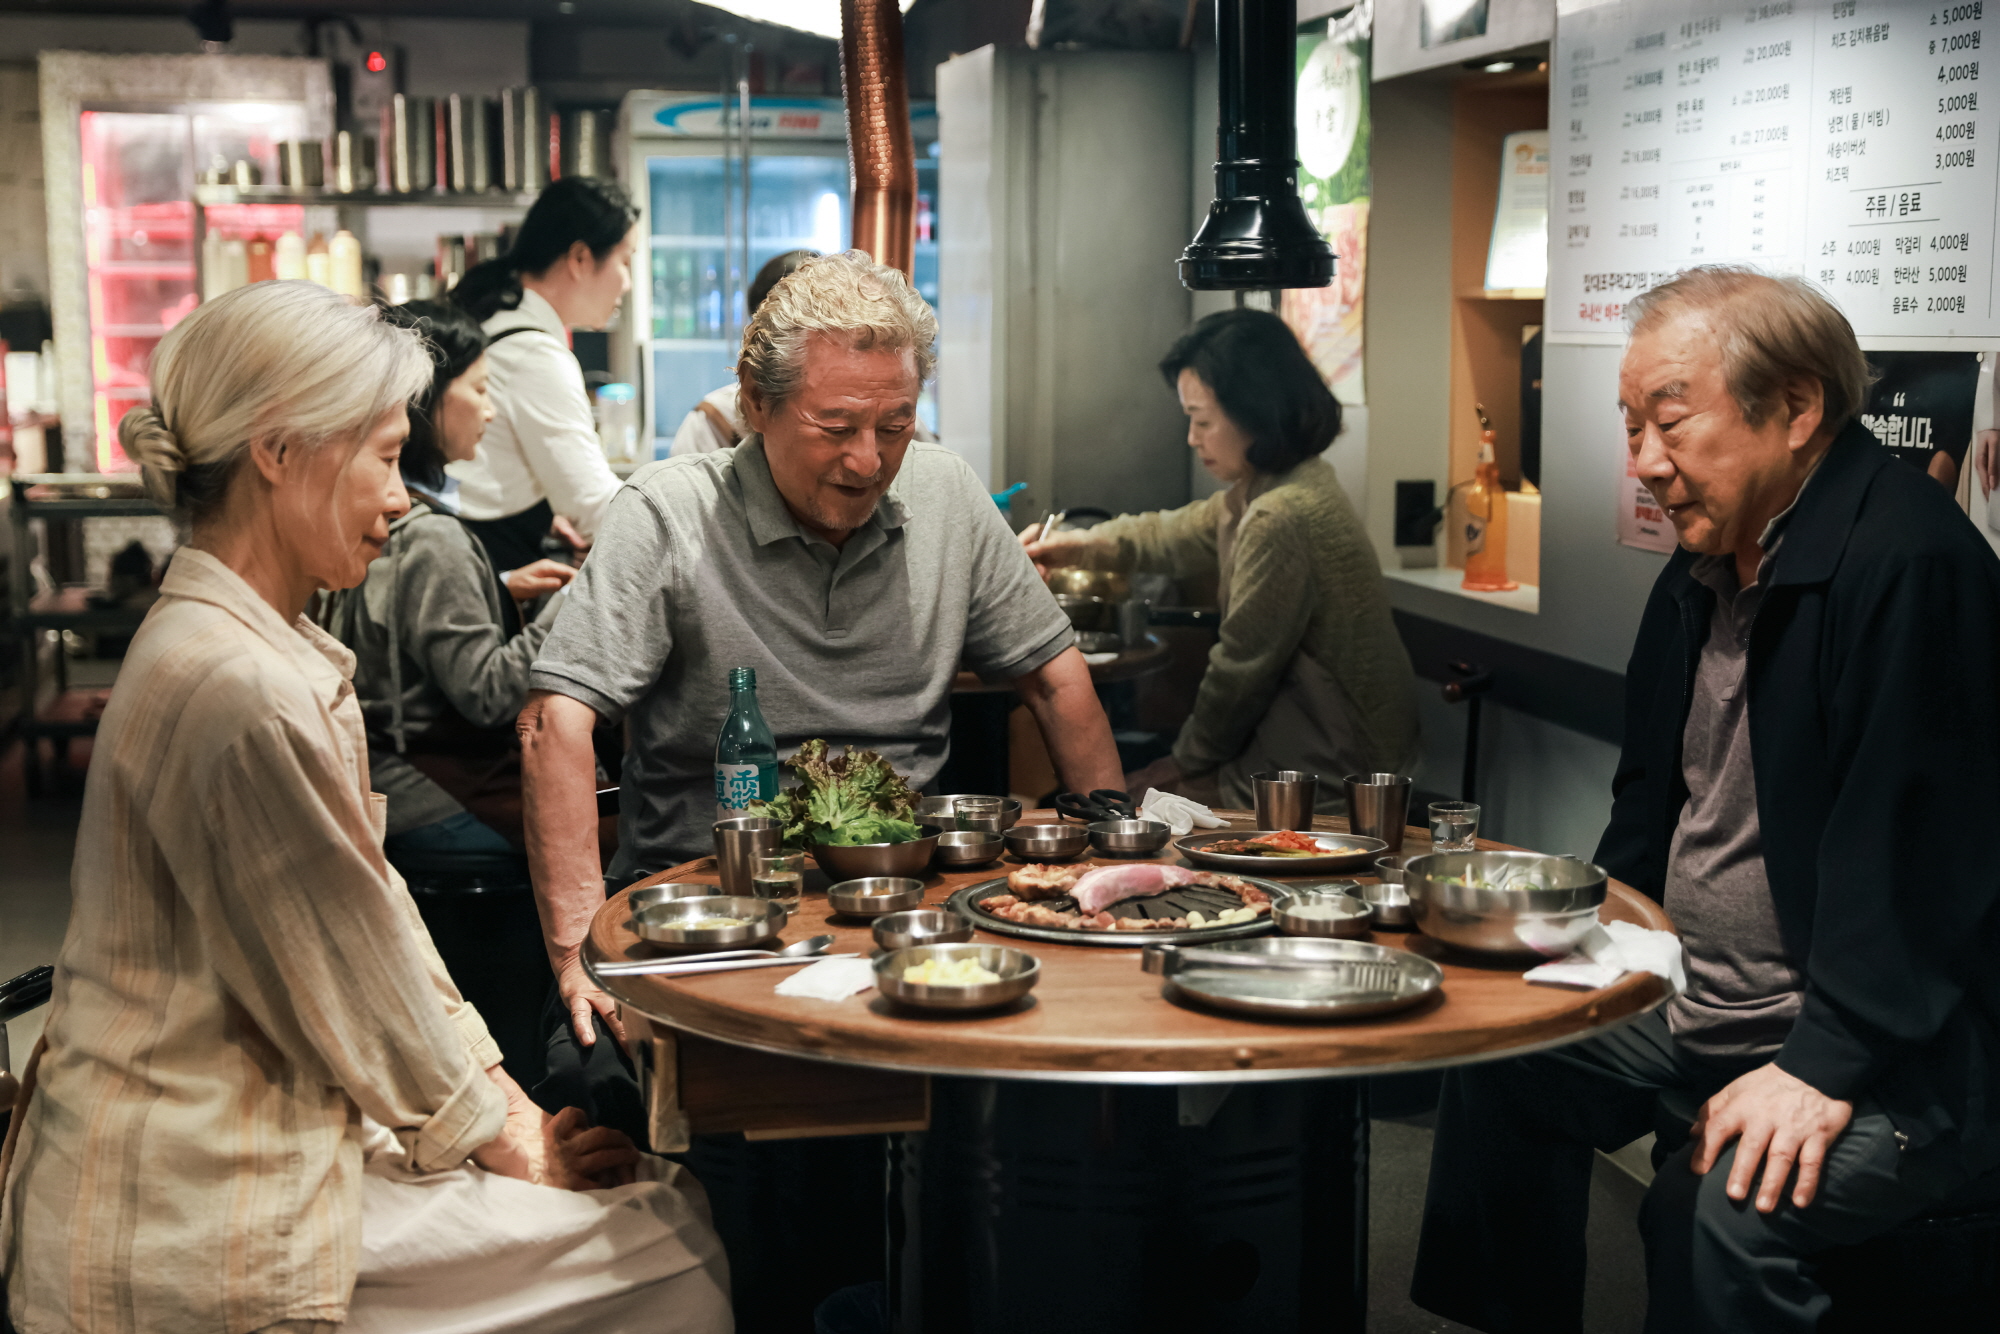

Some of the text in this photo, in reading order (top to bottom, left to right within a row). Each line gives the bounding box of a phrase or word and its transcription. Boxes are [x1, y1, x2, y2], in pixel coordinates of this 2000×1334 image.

[1930, 1, 1983, 26] 소 5,000원
[1831, 22, 1890, 49] 치즈 김치볶음밥
[1929, 30, 1981, 55] 중 7,000원
[1757, 39, 1791, 61] 20,000원
[1937, 61, 1979, 85] 4,000원
[1755, 83, 1789, 103] 20,000원
[1828, 86, 1853, 105] 계란찜
[1938, 91, 1978, 114] 5,000원
[1754, 125, 1788, 144] 27,000원
[1828, 116, 1843, 134] 냉면
[1935, 120, 1976, 142] 4,000원
[1826, 138, 1867, 159] 새송이버섯
[1935, 148, 1975, 170] 3,000원
[1865, 192, 1922, 218] 주류 / 음료
[1821, 238, 1881, 256] 소주 4,000원
[1895, 232, 1970, 255] 막걸리 4,000원
[1820, 267, 1880, 286] 맥주 4,000원
[1894, 264, 1968, 285] 한라산 5,000원
[1892, 294, 1966, 315] 음료수 2,000원
